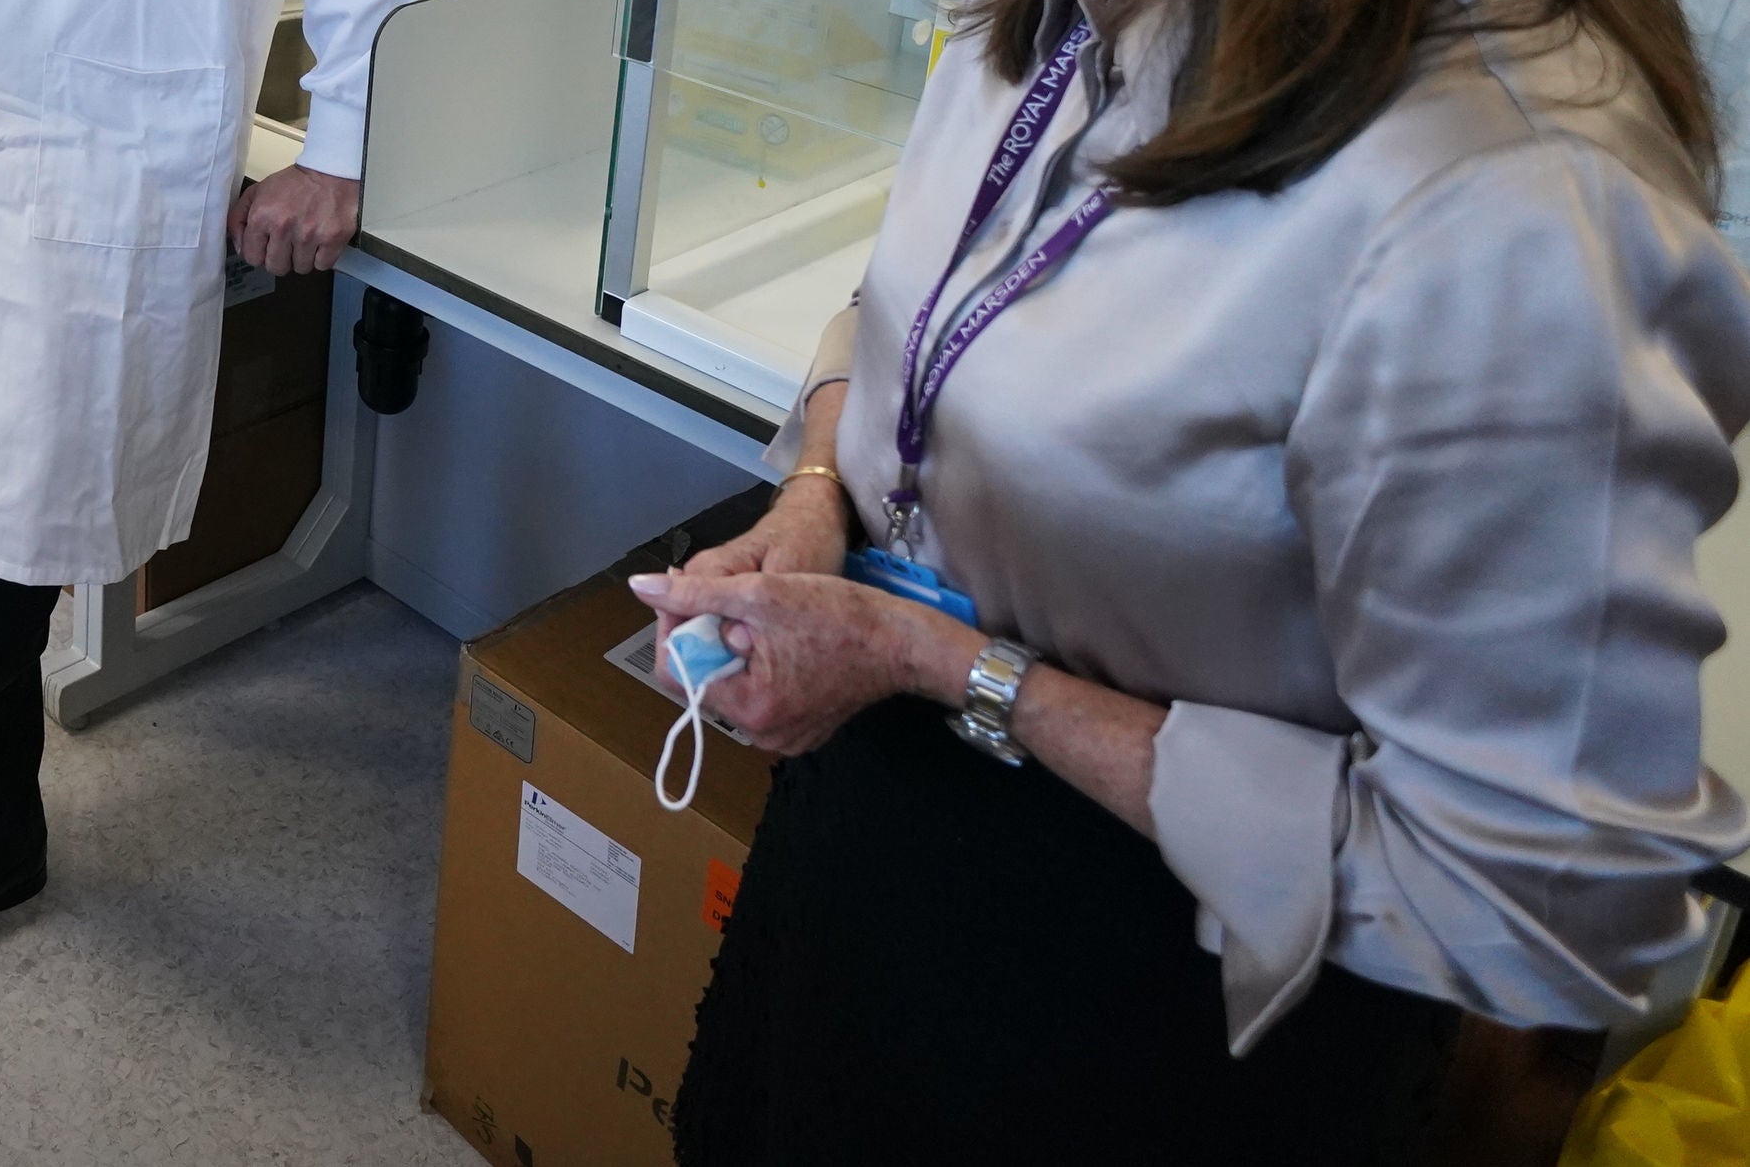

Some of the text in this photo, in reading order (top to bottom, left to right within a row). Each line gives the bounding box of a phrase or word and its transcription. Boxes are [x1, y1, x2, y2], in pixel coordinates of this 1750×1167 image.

[986, 154, 1015, 186] The
[1003, 92, 1055, 154] ROYAL
[1071, 195, 1100, 226] The
[924, 249, 1047, 396] ROYAL MARSDEN
